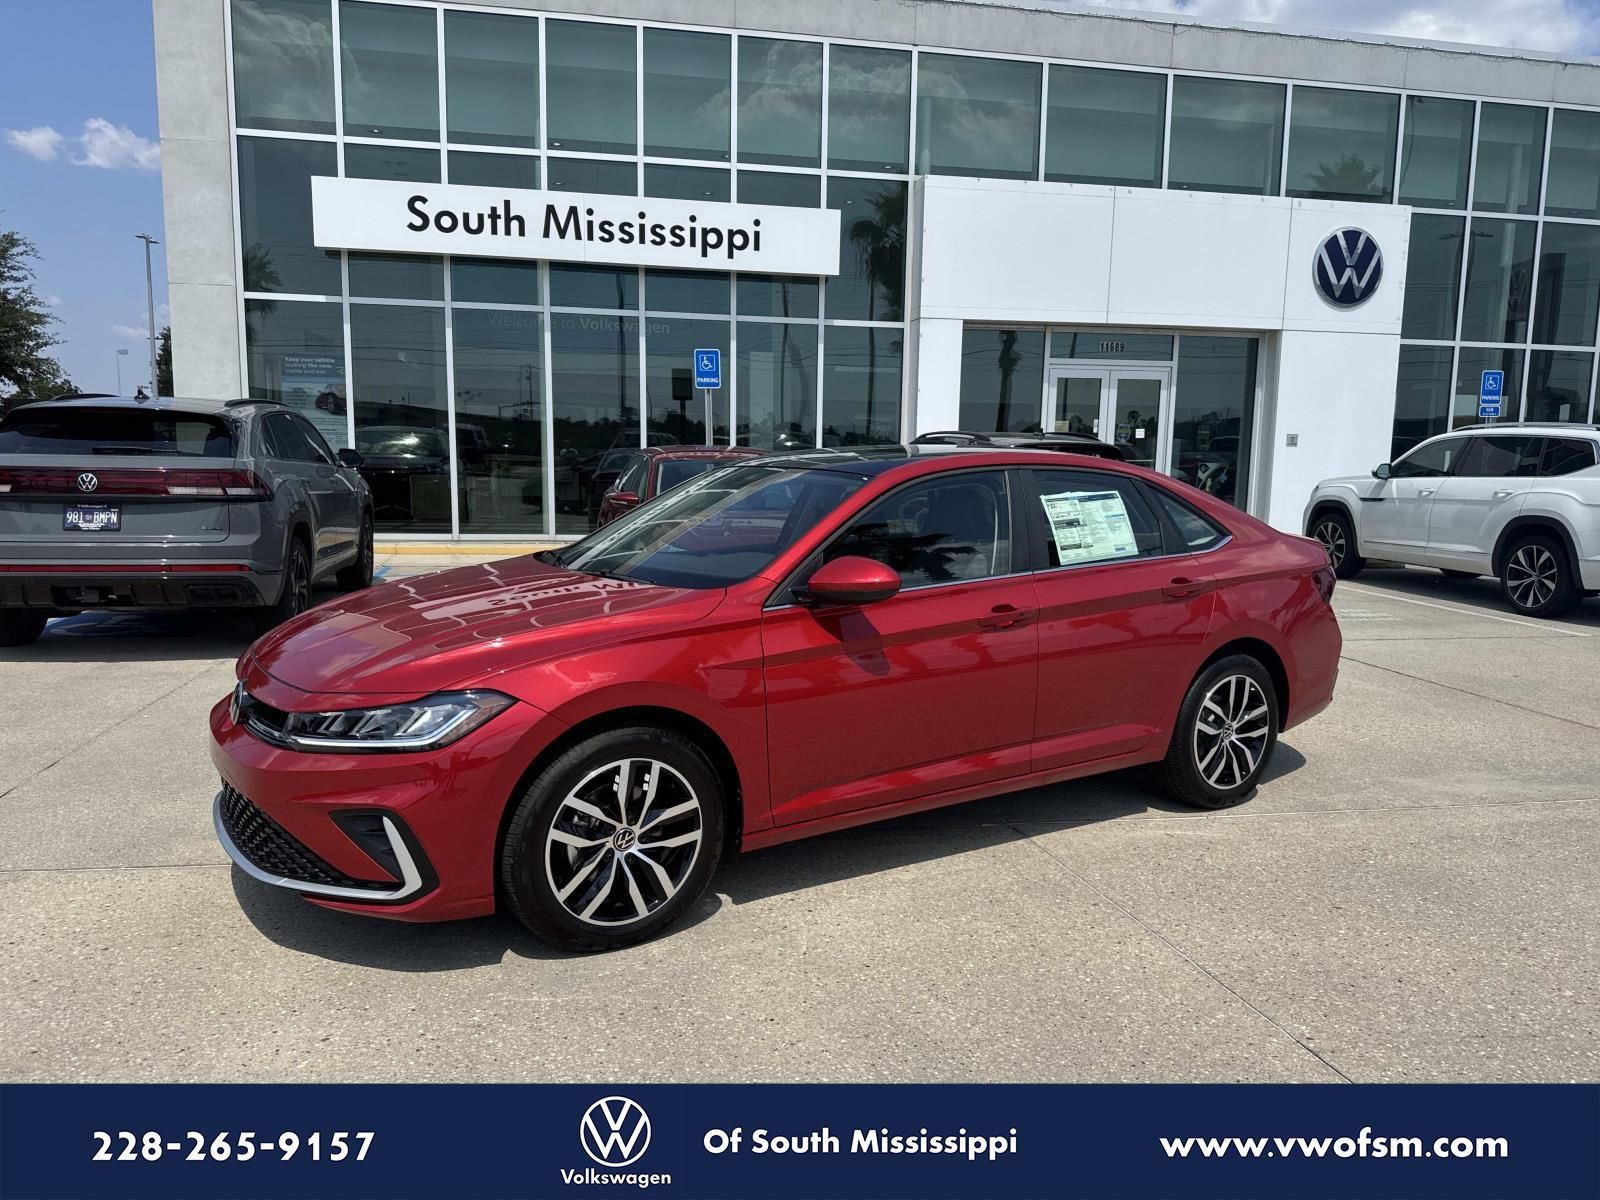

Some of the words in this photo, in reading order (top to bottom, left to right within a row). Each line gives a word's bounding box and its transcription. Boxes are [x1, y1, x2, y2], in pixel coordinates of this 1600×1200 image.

[407, 196, 525, 236] South
[543, 205, 760, 259] Mississippi
[1312, 226, 1383, 308] VW
[562, 317, 575, 330] to
[580, 318, 670, 337] Volkswagen
[1100, 342, 1125, 353] 11689
[66, 511, 84, 523] 981
[93, 511, 118, 524] BMPN
